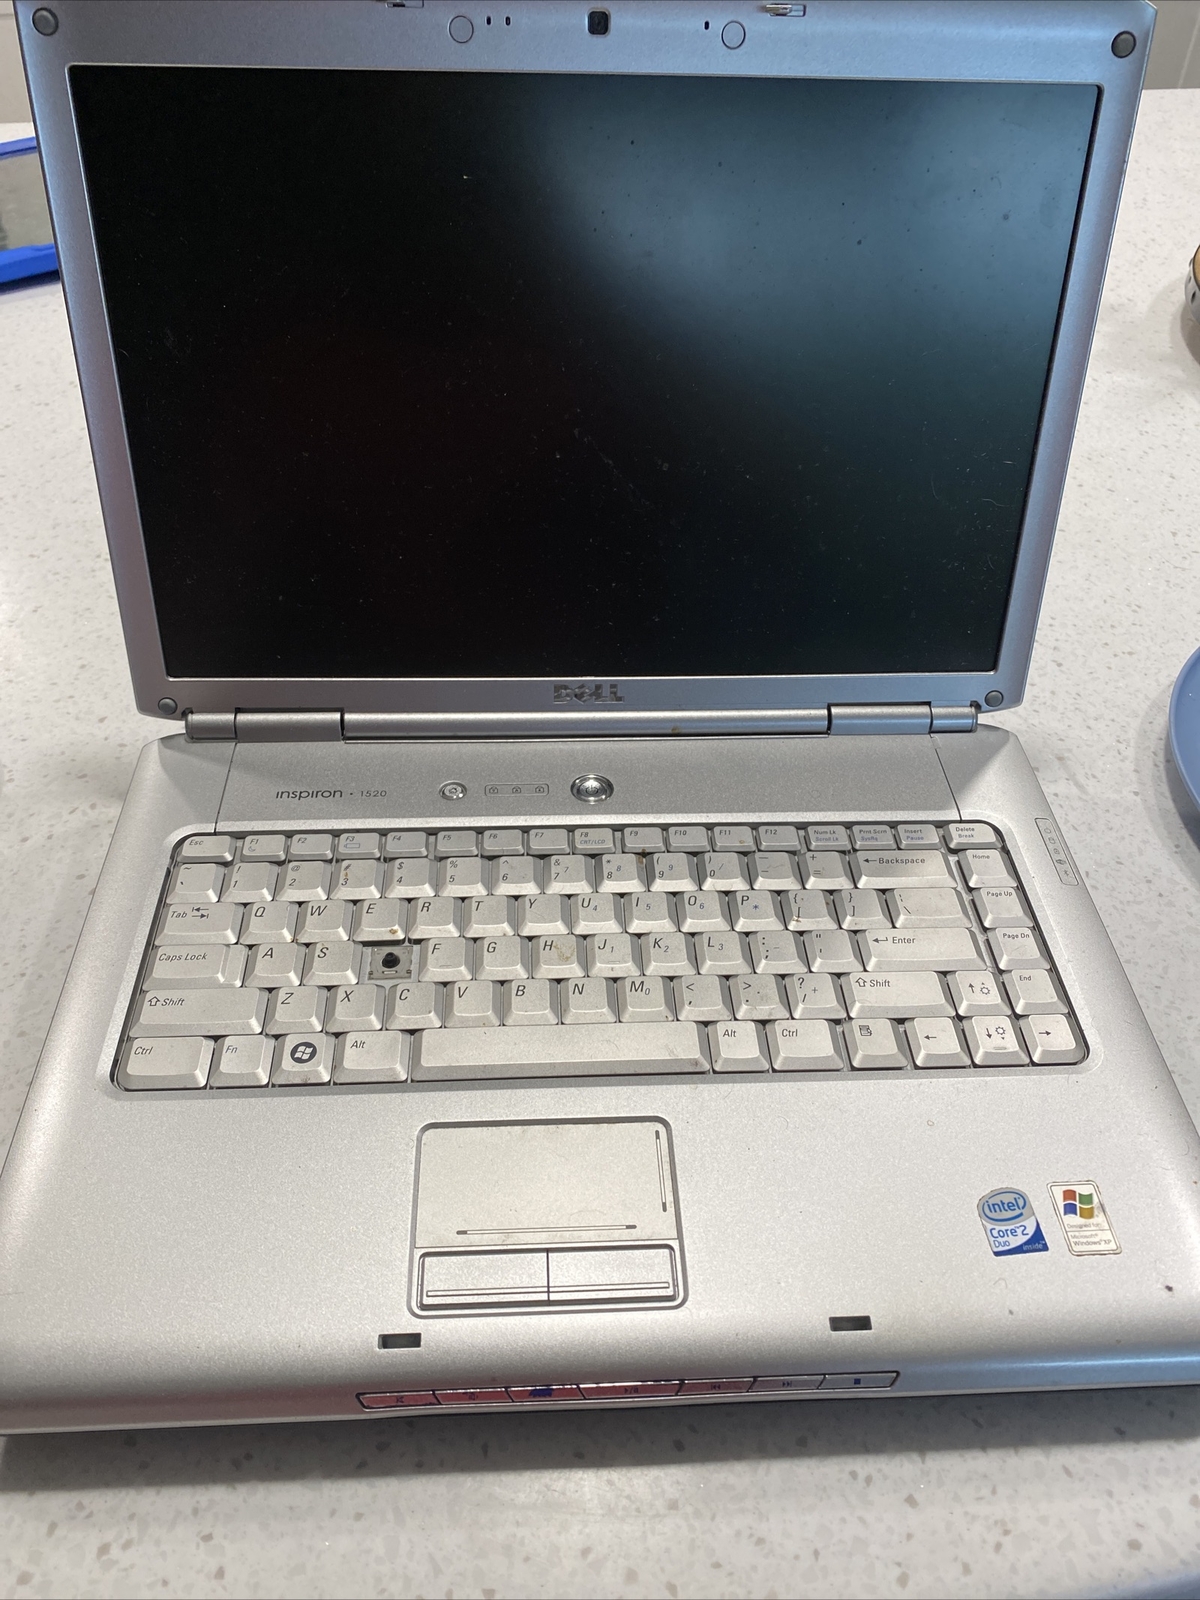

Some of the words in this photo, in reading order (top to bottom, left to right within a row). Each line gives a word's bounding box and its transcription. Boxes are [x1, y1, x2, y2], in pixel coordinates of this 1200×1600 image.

[553, 683, 625, 705] DELL
[275, 787, 343, 801] inspiron
[360, 789, 387, 798] 1520
[188, 838, 204, 846] Esc
[345, 835, 355, 843] F3
[397, 861, 405, 870] $
[449, 860, 458, 869] %
[553, 858, 561, 866] &
[878, 856, 926, 866] Backspace
[290, 864, 300, 872] @
[449, 874, 455, 883] 5
[502, 873, 508, 881] 6
[554, 872, 560, 881] 7
[606, 871, 613, 879] 8
[658, 870, 664, 879] 9
[288, 878, 296, 886] 2
[341, 877, 349, 885] 3
[396, 876, 403, 884] 4
[528, 899, 537, 909] Y
[581, 898, 592, 909] U
[688, 895, 697, 906] O
[741, 895, 750, 906] P
[310, 905, 327, 917] W
[365, 903, 377, 914] E
[421, 901, 431, 912] R
[474, 901, 484, 912] T
[170, 910, 188, 919] Tab
[254, 906, 267, 918] Q
[597, 938, 607, 950] J
[653, 937, 664, 949] K
[707, 937, 715, 948] L
[892, 936, 916, 944] Enter
[431, 944, 441, 954] F
[486, 942, 497, 953] G
[543, 940, 554, 951] H
[158, 953, 182, 962] Caps
[184, 952, 208, 961] Lock
[262, 947, 274, 959] A
[317, 947, 329, 959] S
[629, 981, 645, 993] M
[797, 977, 805, 989] ?
[869, 979, 891, 988] Shift
[458, 986, 468, 998] V
[515, 985, 526, 997] B
[572, 983, 585, 995] N
[281, 992, 294, 1005] Z
[340, 990, 354, 1003] X
[398, 988, 410, 1001] C
[161, 997, 185, 1007] Shift
[723, 1029, 737, 1038] Alt
[781, 1028, 798, 1038] Ctrl
[225, 1045, 238, 1054] Fn
[350, 1040, 365, 1049] Alt
[134, 1046, 153, 1056] Ctrl
[986, 1196, 1020, 1214] intel
[993, 1239, 1011, 1249] Duo
